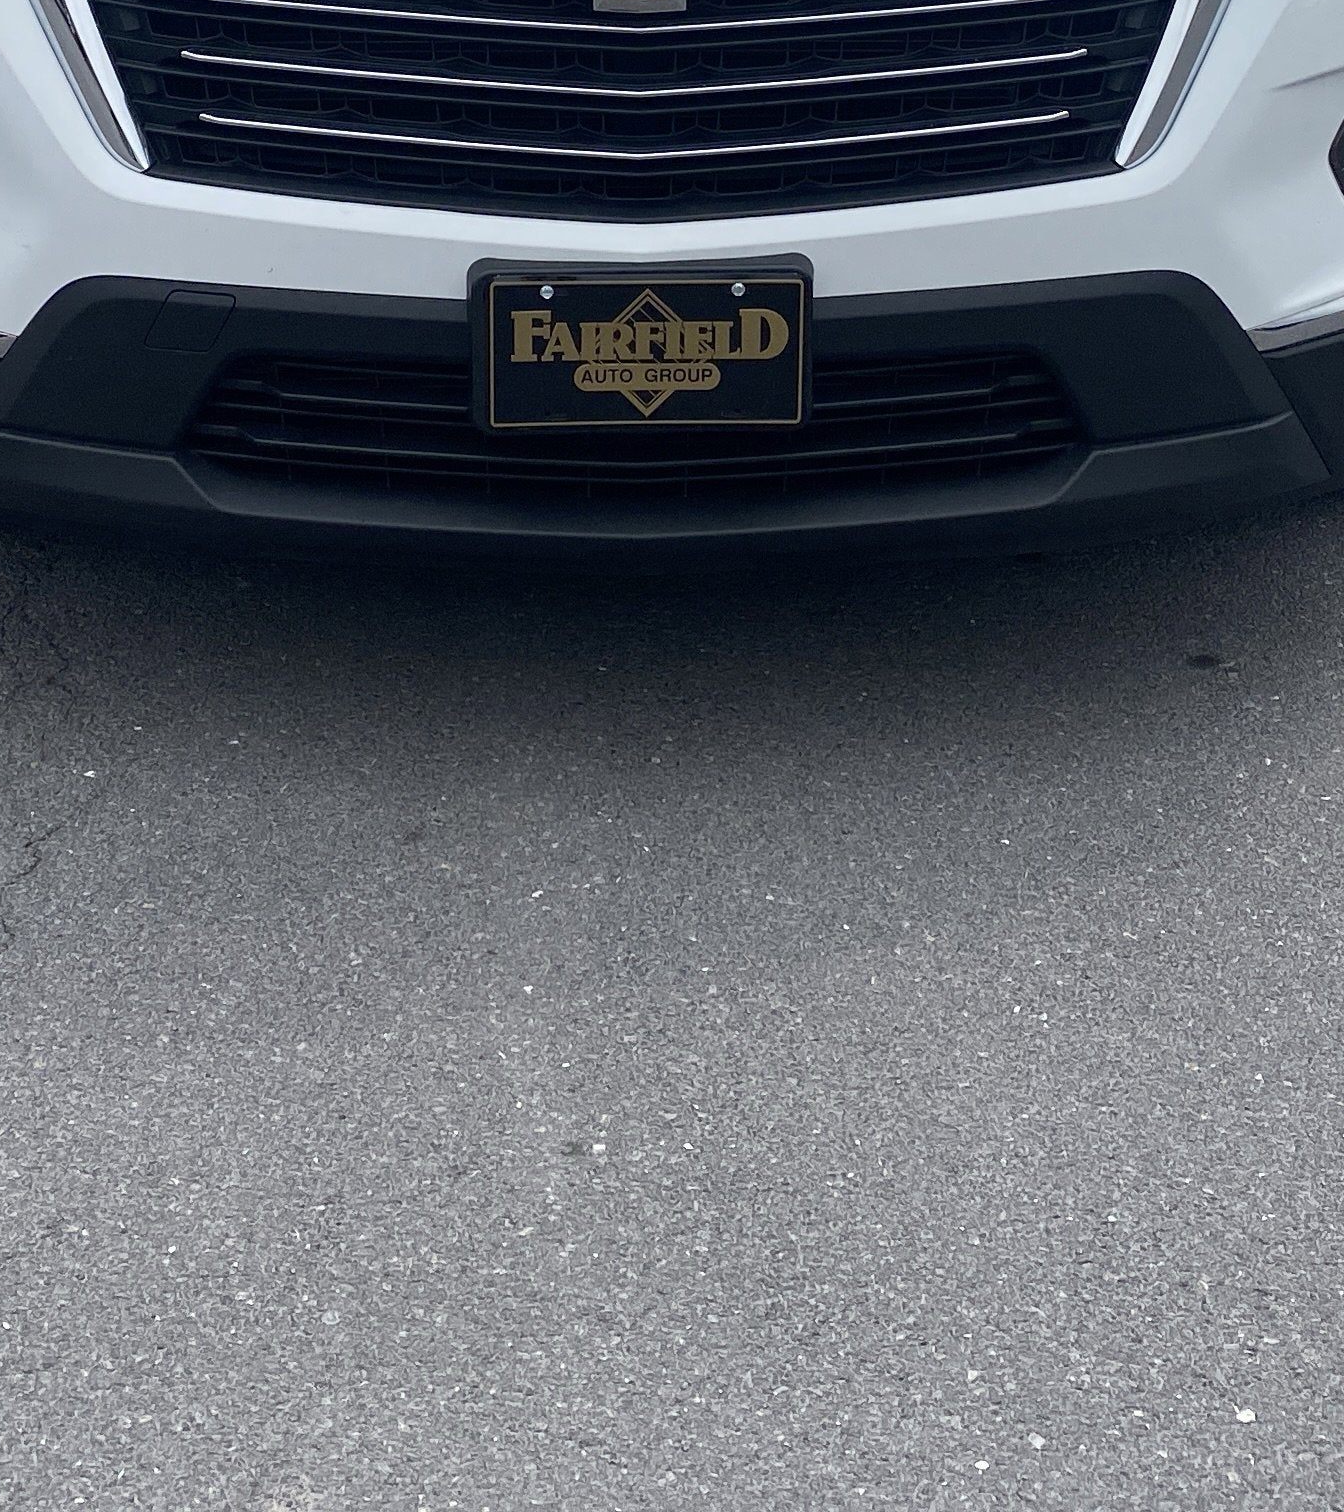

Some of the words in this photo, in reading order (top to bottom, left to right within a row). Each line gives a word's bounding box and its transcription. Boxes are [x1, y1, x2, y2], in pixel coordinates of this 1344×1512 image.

[510, 308, 789, 362] FAIRFIELD
[580, 368, 634, 385] AUTO
[643, 366, 714, 384] GROUP
